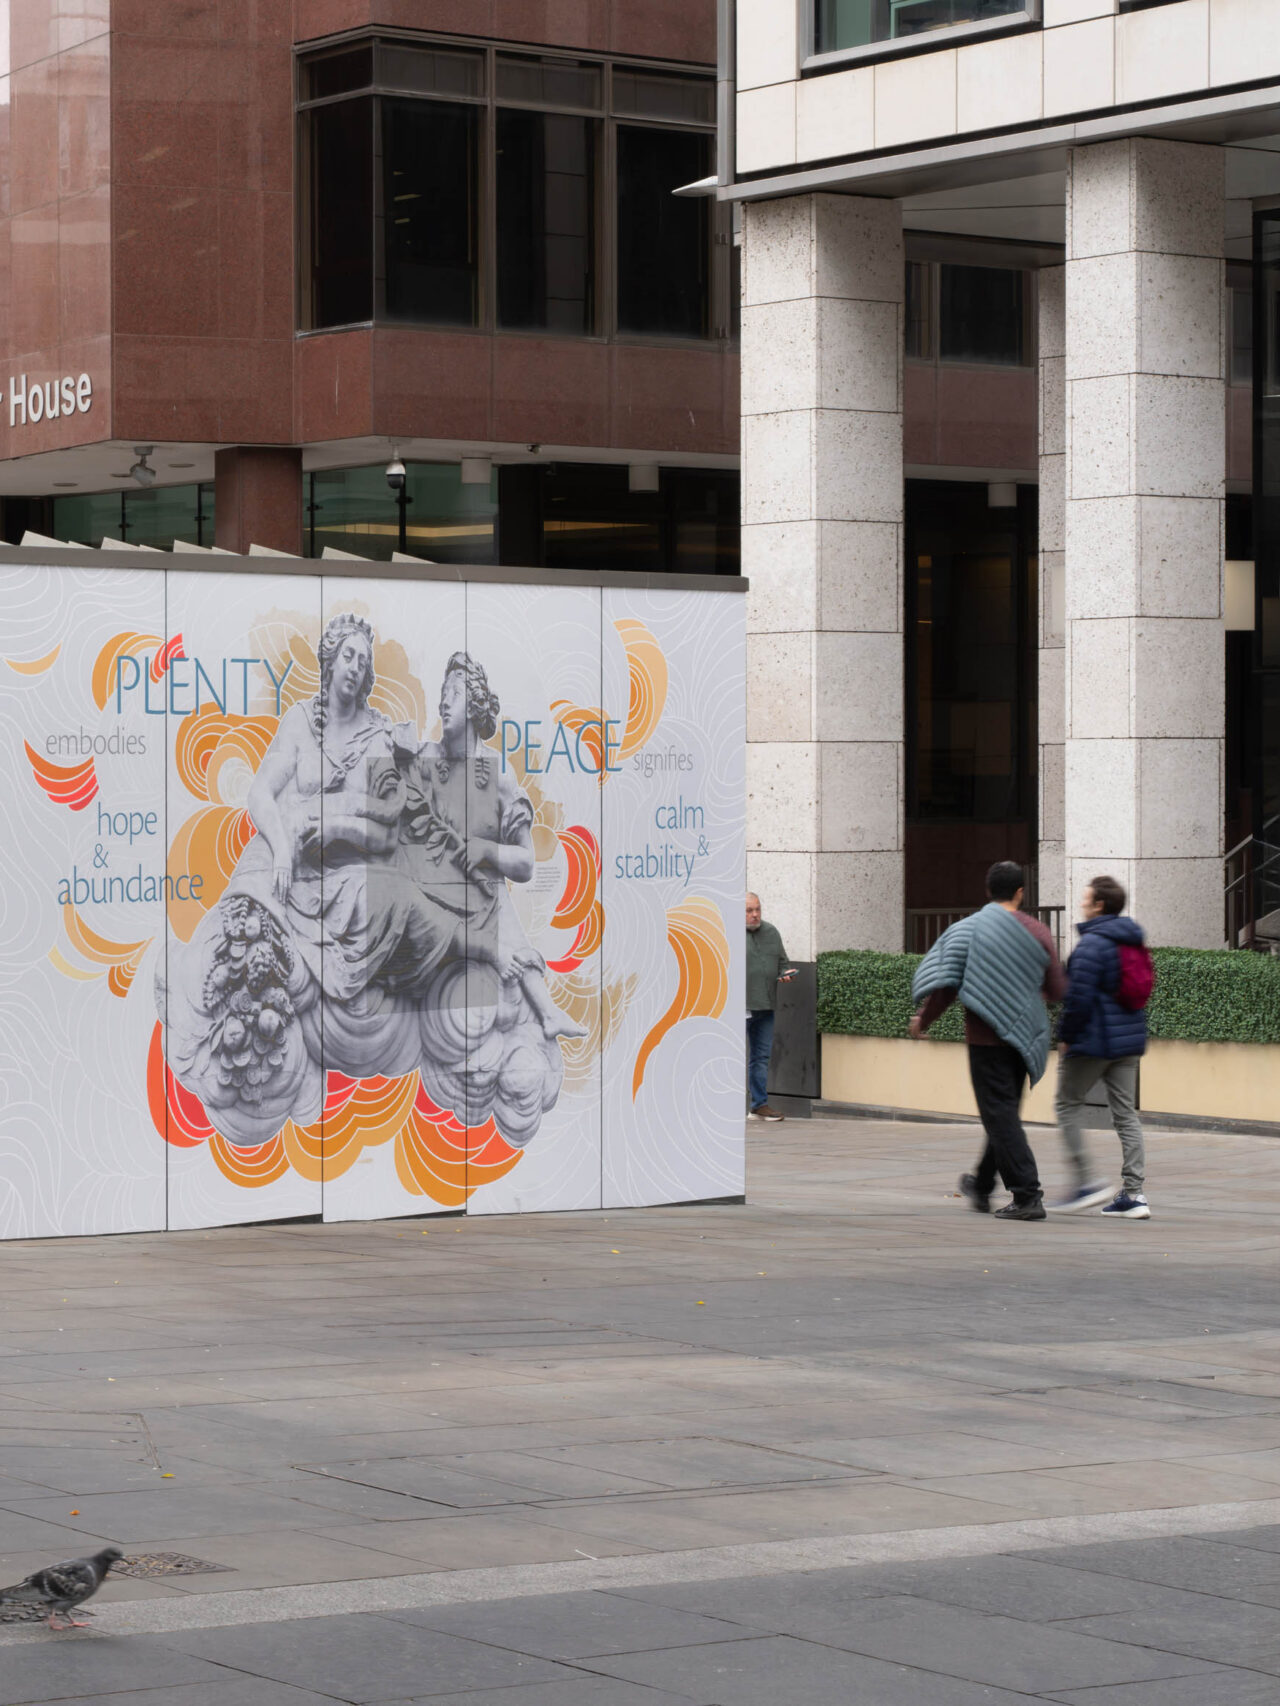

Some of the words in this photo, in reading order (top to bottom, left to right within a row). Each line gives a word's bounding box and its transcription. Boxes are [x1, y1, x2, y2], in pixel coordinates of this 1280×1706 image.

[10, 373, 93, 427] House
[117, 655, 293, 716] PLENTY
[45, 726, 146, 755] embodies
[501, 720, 623, 774] PEACE
[633, 745, 694, 778] signifies
[98, 801, 157, 845] hope
[655, 795, 704, 829] calm
[93, 843, 109, 869] &
[615, 843, 695, 887] stability
[698, 834, 710, 856] &
[57, 864, 203, 905] abundance
